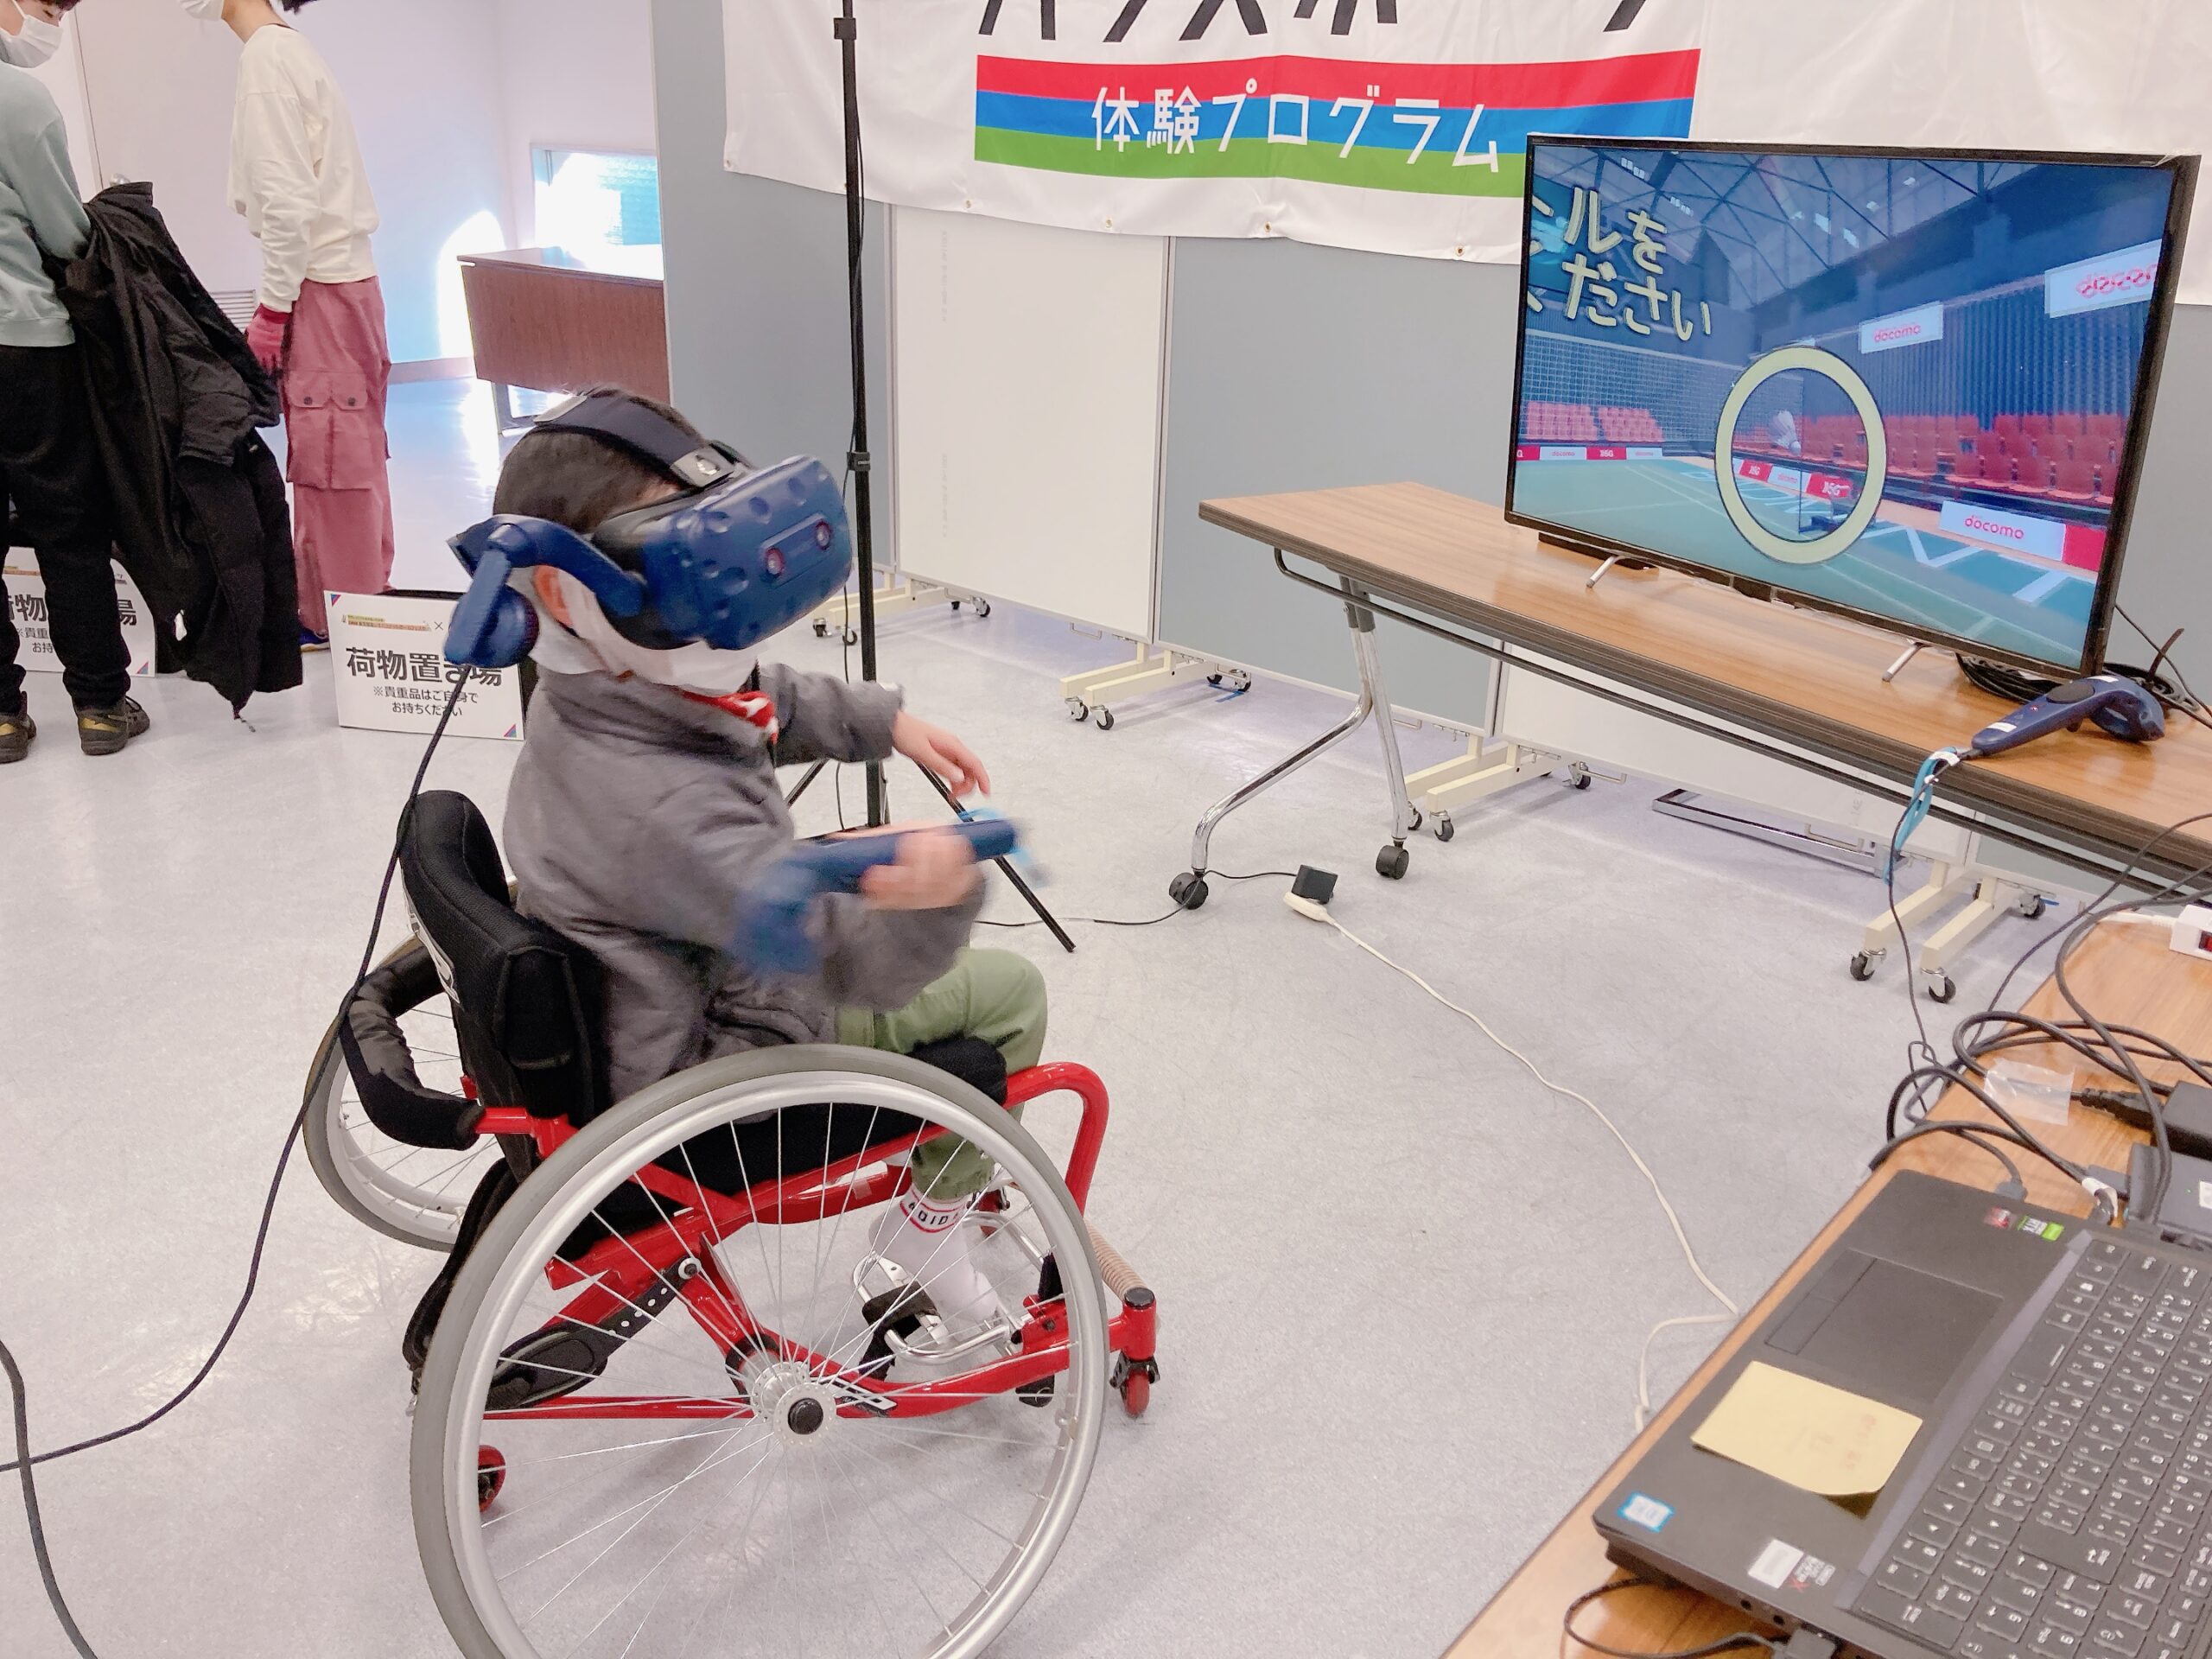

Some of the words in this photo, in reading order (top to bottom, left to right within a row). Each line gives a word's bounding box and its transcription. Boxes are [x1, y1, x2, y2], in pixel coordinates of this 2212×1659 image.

[1091, 78, 1499, 173] 体験プログラム
[1872, 323, 1922, 342] docomo
[1964, 516, 2024, 540] docomo
